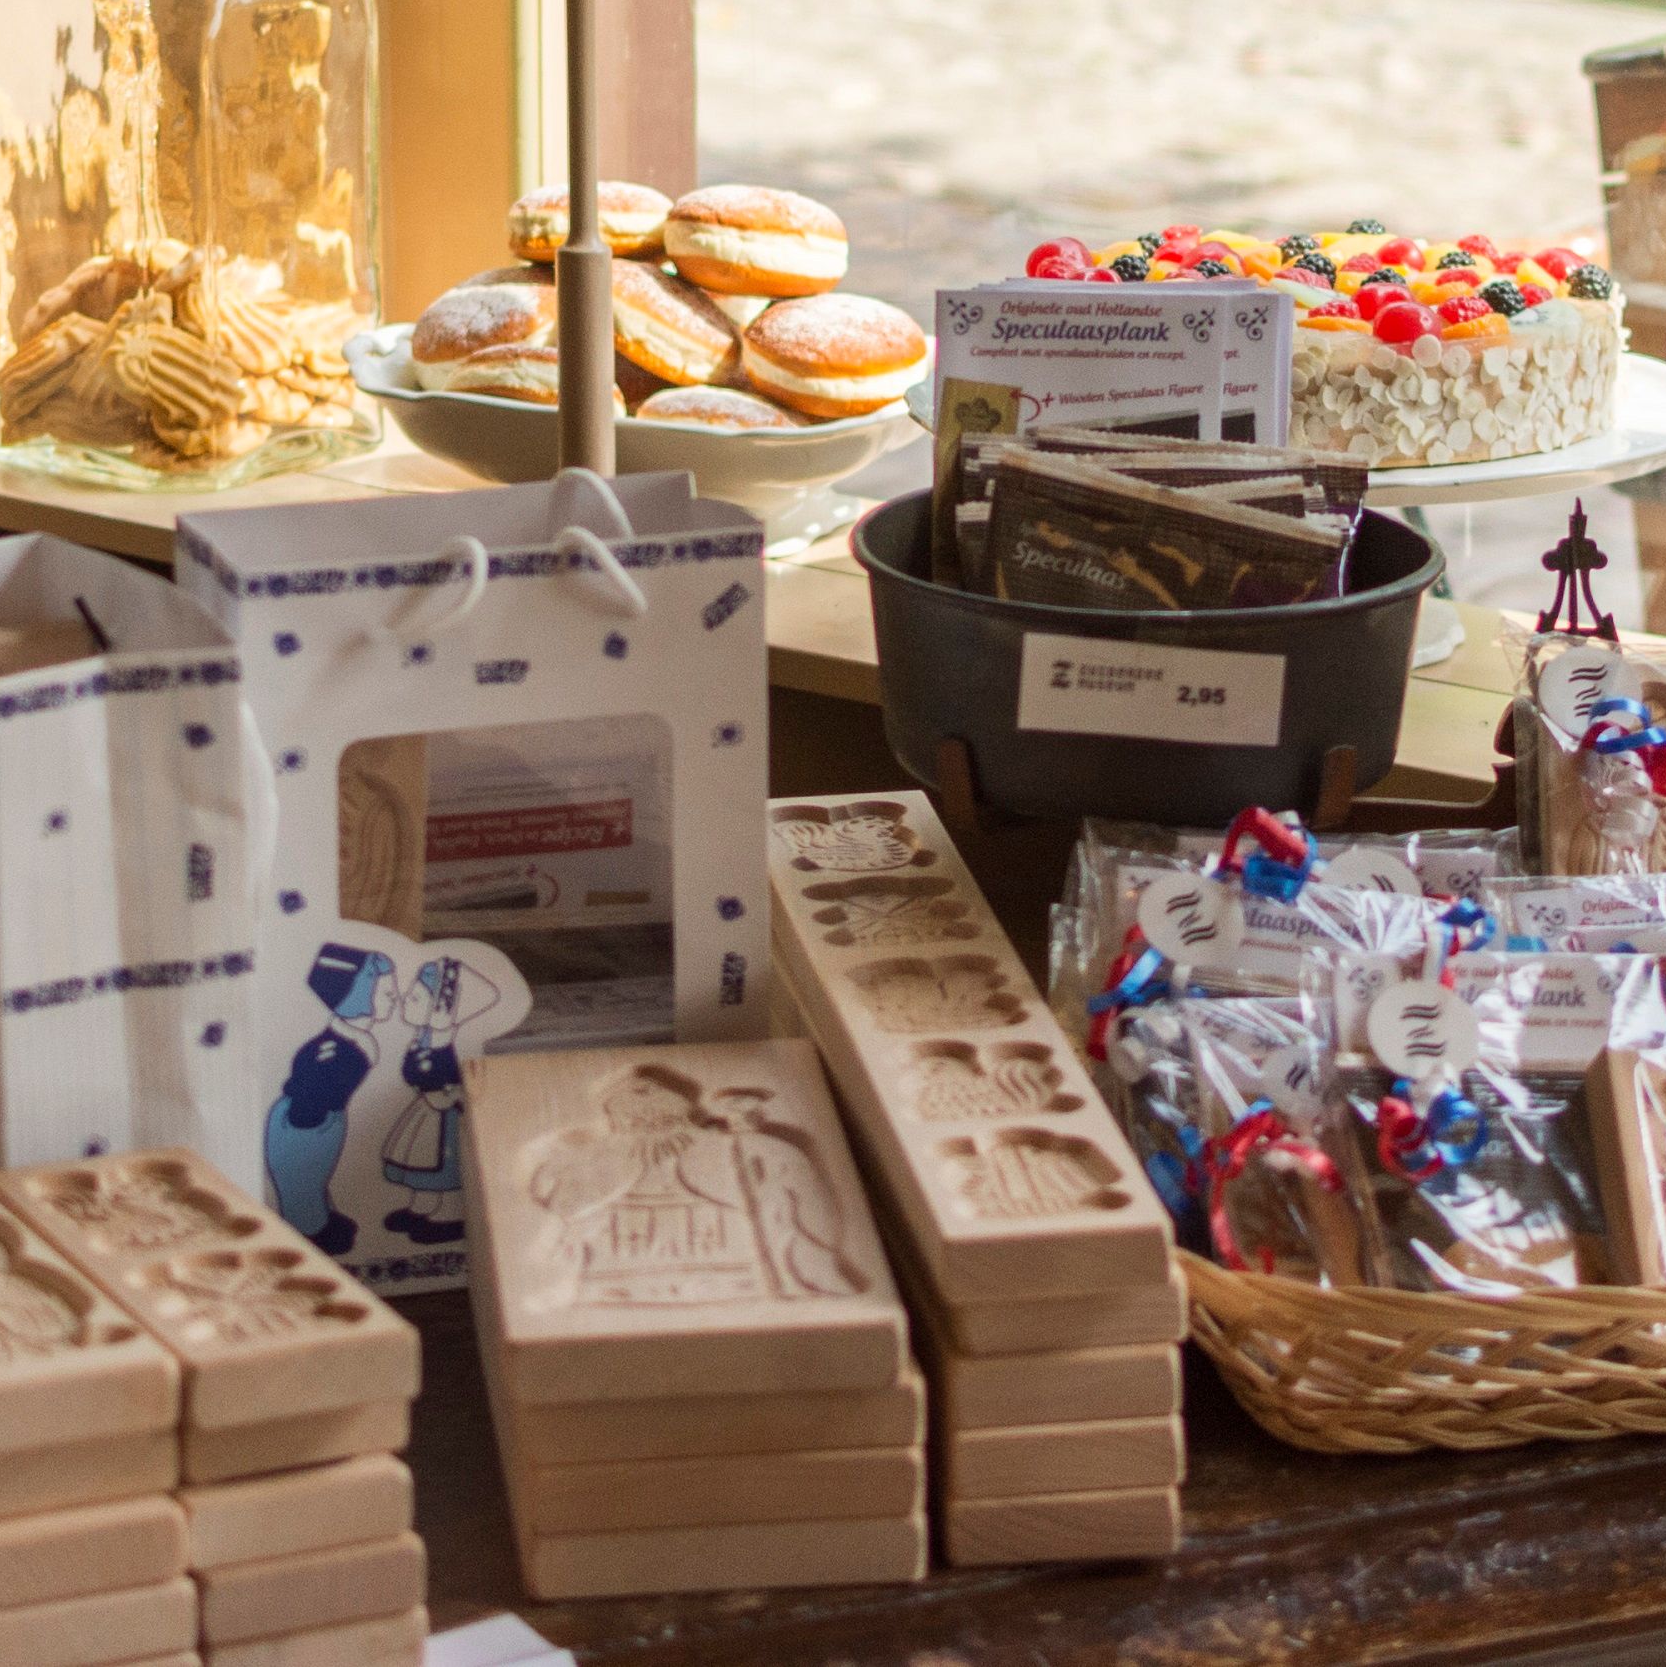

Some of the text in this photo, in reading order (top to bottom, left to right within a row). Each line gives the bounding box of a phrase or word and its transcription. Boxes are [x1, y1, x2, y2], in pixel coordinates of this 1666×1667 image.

[1095, 301, 1163, 318] Hollandse
[991, 316, 1171, 346] Speculaasplank
[1059, 389, 1106, 406] Wooden
[1107, 386, 1165, 404] Speculaas
[1167, 383, 1204, 400] Figure
[1013, 541, 1126, 590] Speculaas
[1177, 685, 1227, 707] 2,95
